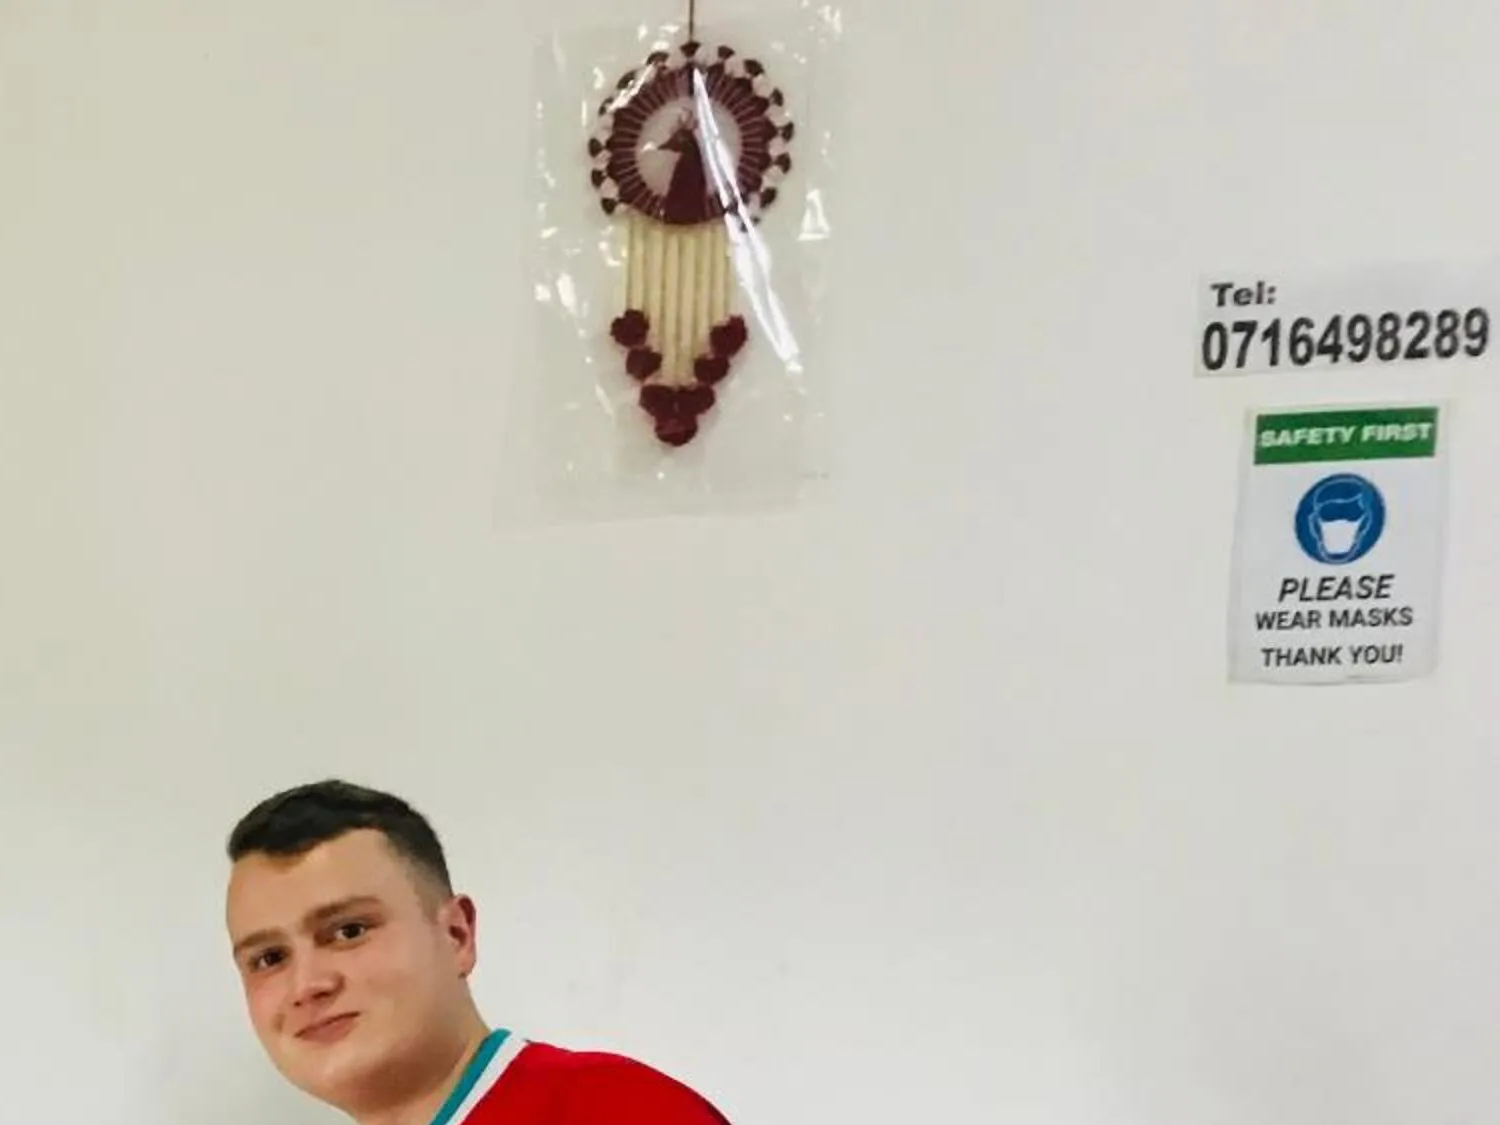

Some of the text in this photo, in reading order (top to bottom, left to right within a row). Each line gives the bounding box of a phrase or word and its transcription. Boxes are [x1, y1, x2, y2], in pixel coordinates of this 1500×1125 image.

[1210, 281, 1277, 307] Tel:
[1202, 307, 1490, 370] 0716498289
[1260, 422, 1432, 448] SAFETY FIRST
[1278, 574, 1395, 602] PLEASE
[1256, 607, 1414, 630] WEAR MASKS
[1261, 644, 1404, 667] THANK YOU!
